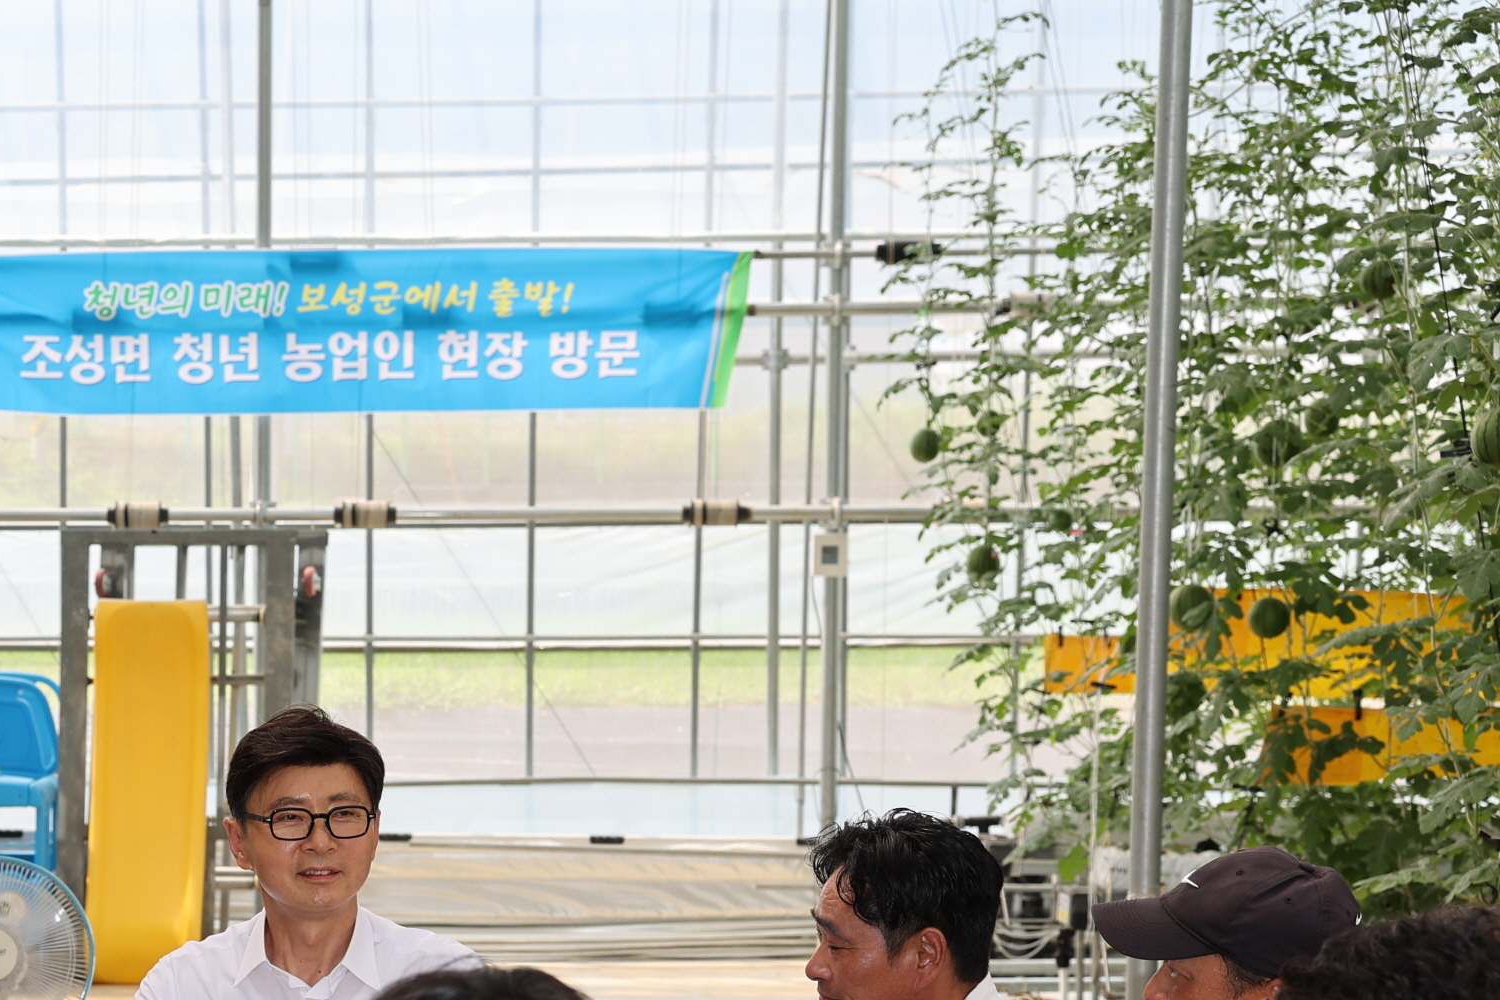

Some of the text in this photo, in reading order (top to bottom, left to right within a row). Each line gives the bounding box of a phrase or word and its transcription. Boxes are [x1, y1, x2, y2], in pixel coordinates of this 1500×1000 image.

[84, 277, 575, 320] 청년의 미래! 보성군에서 출발!
[19, 329, 641, 385] 조성면 청년 농업인 현장 방문
